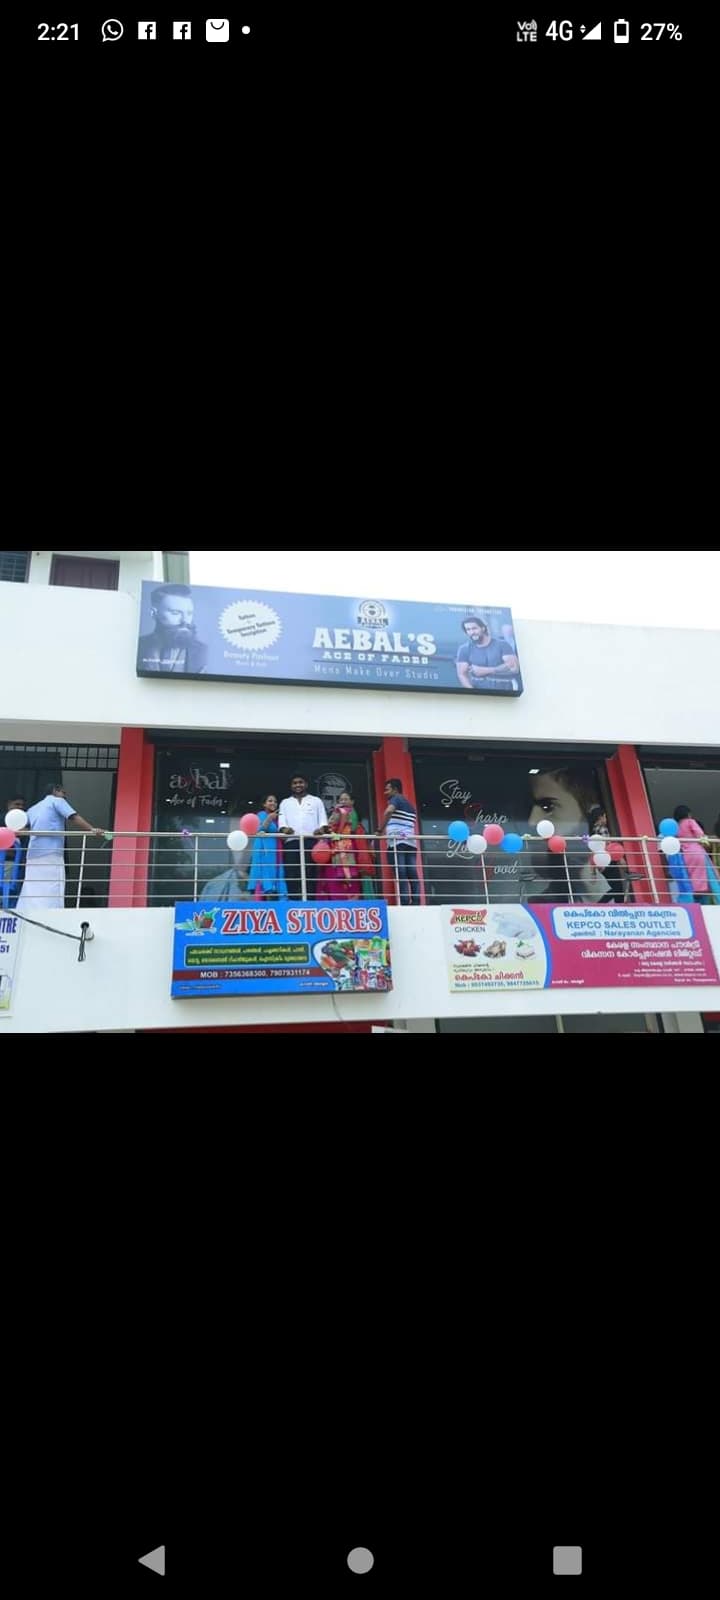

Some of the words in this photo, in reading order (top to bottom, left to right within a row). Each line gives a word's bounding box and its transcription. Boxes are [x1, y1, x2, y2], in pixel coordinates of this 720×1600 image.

[312, 626, 437, 656] AEBAL'S
[323, 651, 352, 661] ACE
[358, 653, 376, 662] OF
[381, 655, 429, 665] FADES
[314, 663, 340, 674] Mens
[344, 666, 371, 677] Make
[376, 669, 400, 679] Over
[405, 670, 439, 681] Studio
[439, 779, 472, 805] Stay
[221, 908, 282, 935] ZIYA
[287, 907, 383, 935] STORES
[566, 921, 602, 929] KEPCO
[604, 921, 636, 929] SALES
[638, 921, 677, 929] OUTLET
[200, 971, 219, 979] MOB
